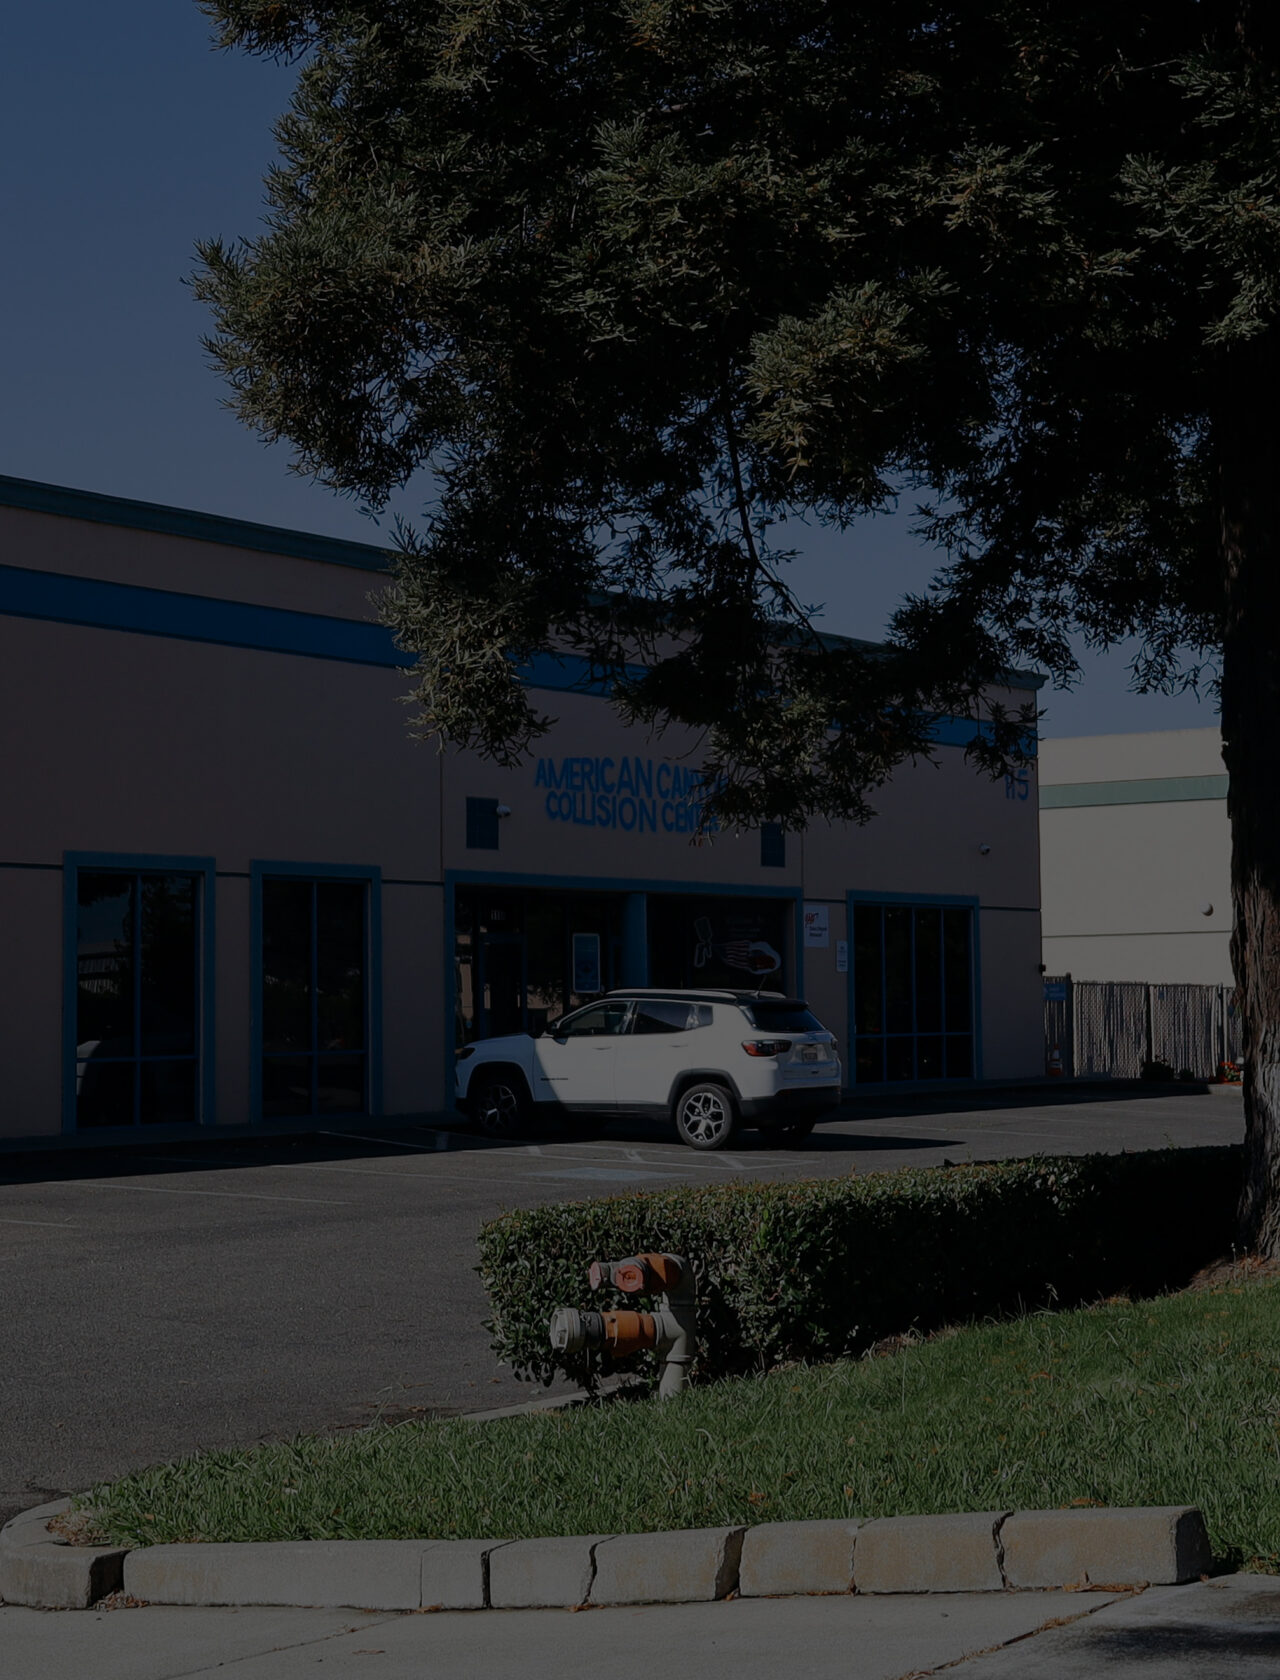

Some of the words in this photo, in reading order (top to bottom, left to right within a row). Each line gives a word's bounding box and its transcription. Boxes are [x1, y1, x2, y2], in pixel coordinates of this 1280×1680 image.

[535, 757, 653, 799] AMERICAN
[657, 763, 729, 799] CAN
[546, 790, 658, 833] COLLISION
[662, 800, 721, 833] CEN
